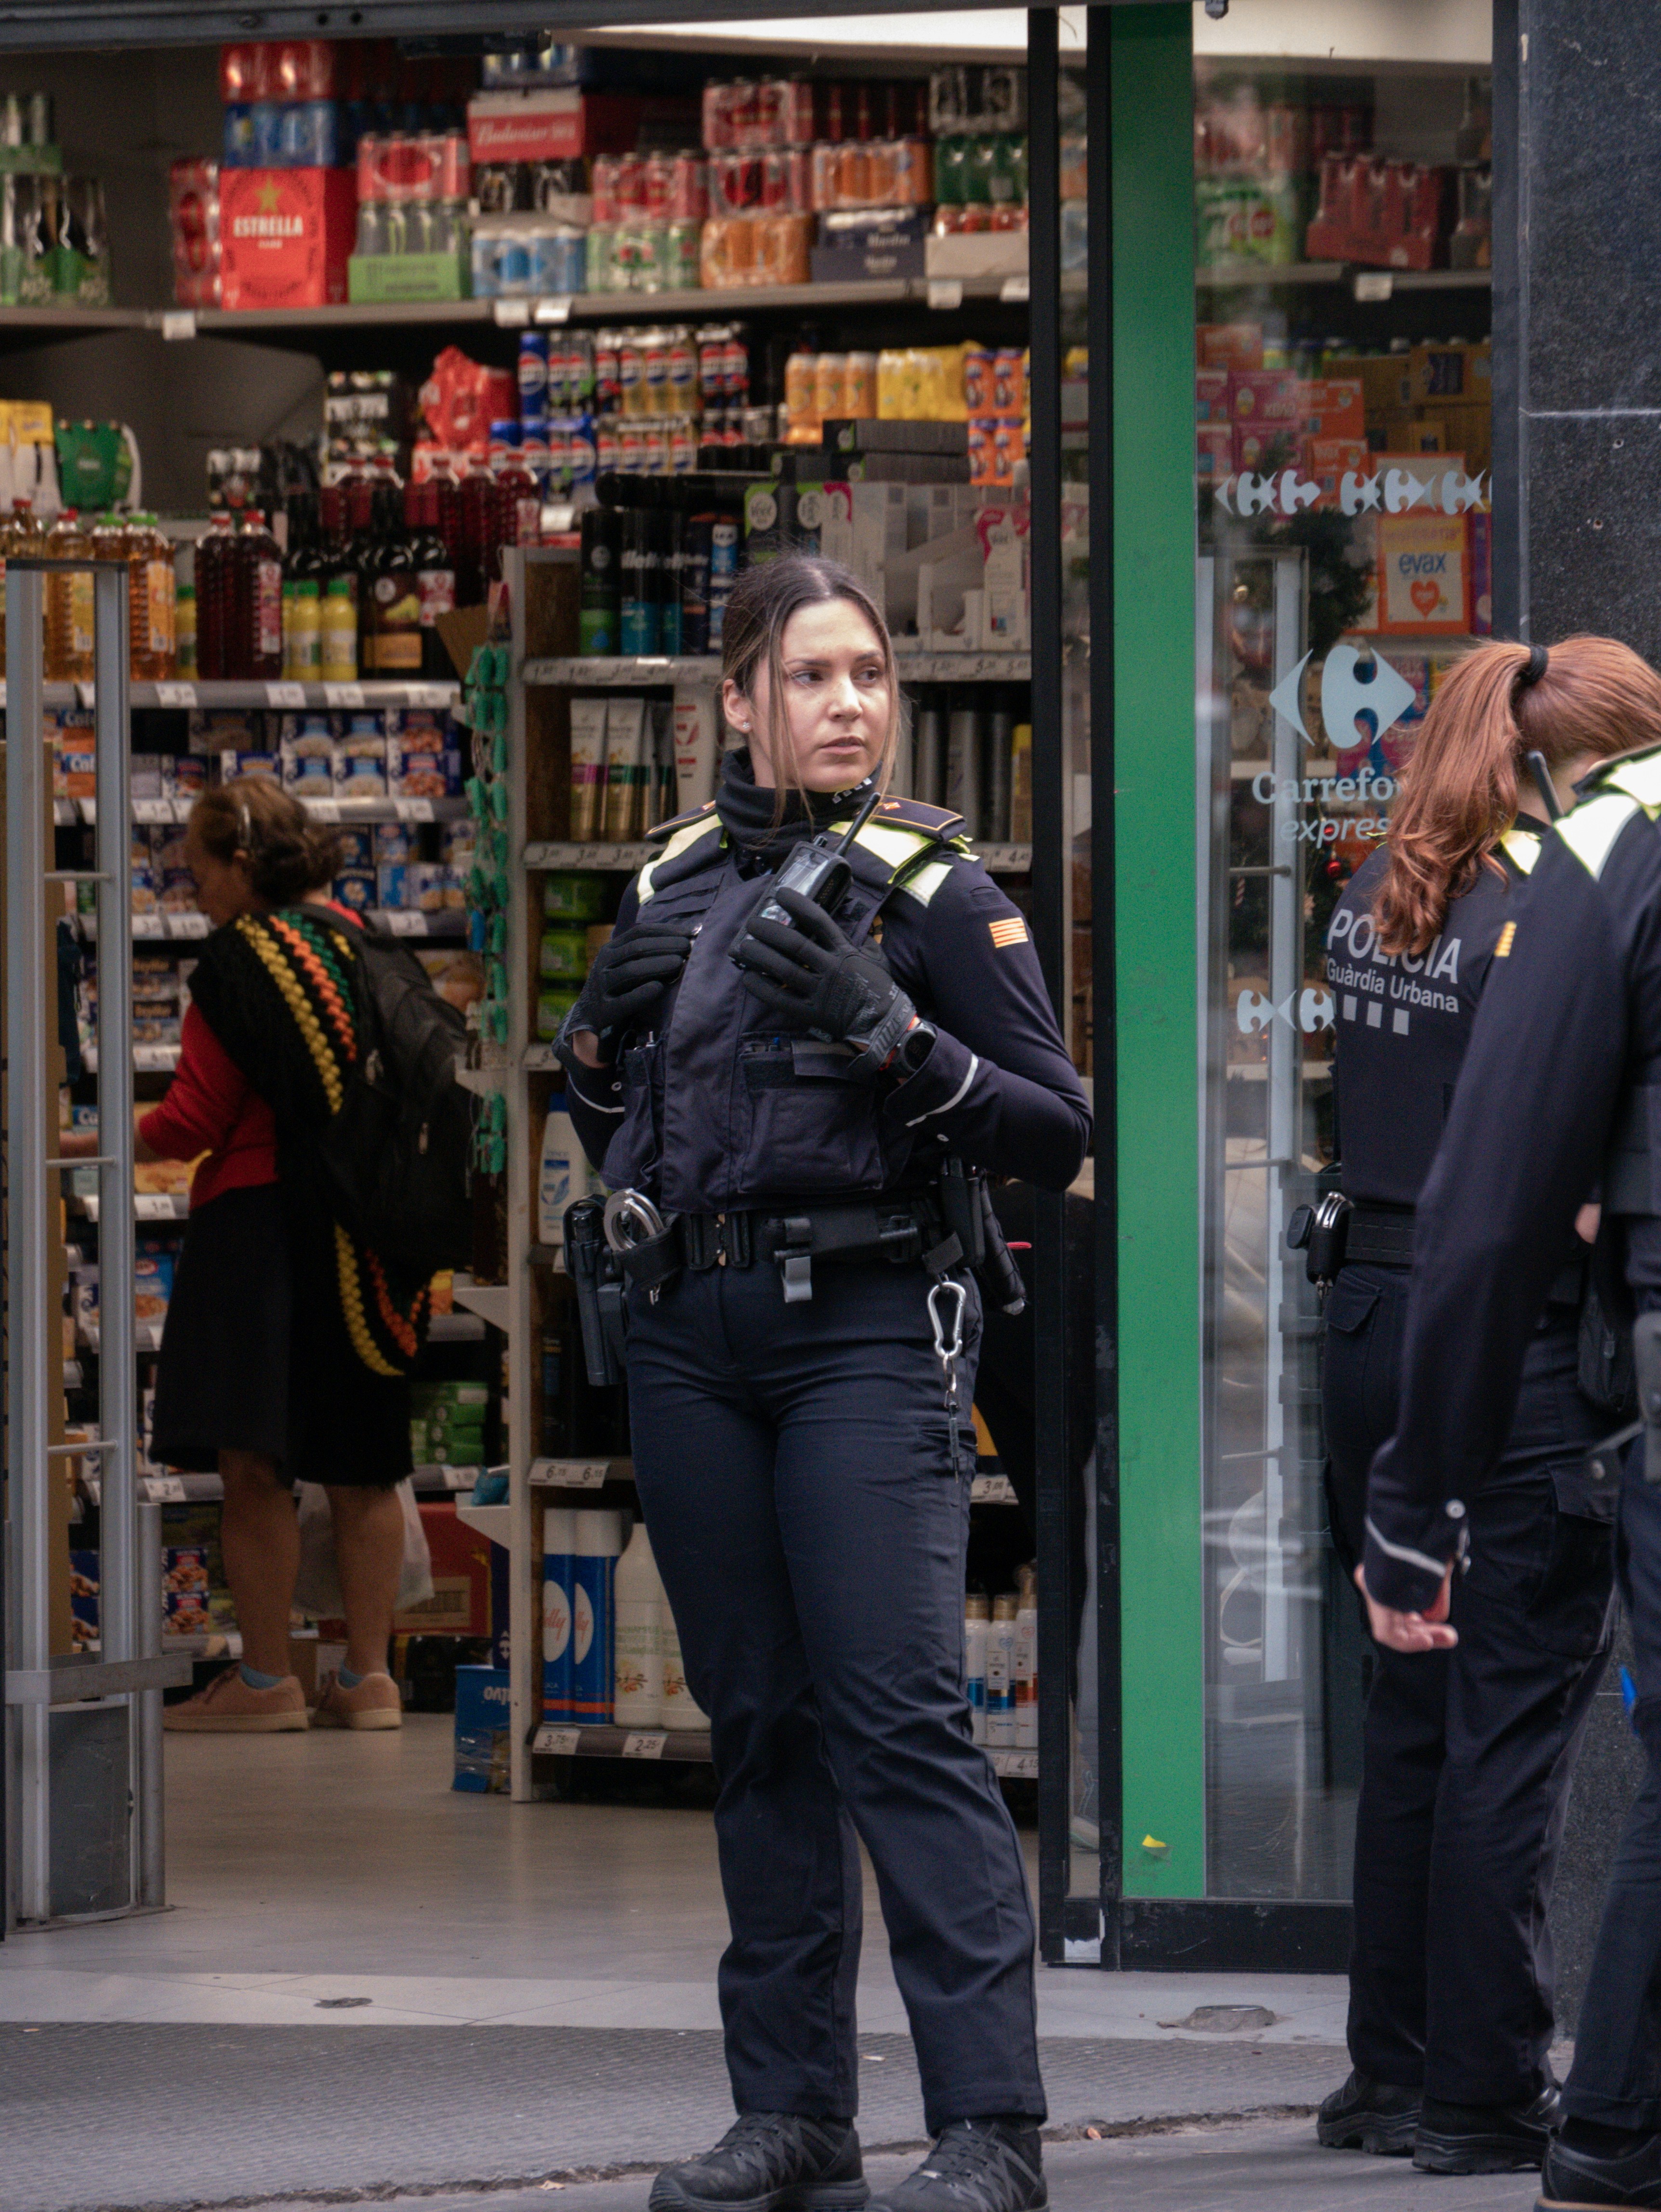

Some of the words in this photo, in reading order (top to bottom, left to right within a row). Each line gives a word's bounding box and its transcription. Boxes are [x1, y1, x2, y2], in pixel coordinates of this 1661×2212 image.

[234, 215, 303, 237] ESTRELLA
[1398, 552, 1446, 575] evax
[1252, 767, 1401, 803] Carrefo
[1280, 817, 1392, 849] expres
[1327, 908, 1462, 984] POLCIA
[1327, 958, 1385, 995] Guàrdia
[1390, 975, 1459, 1013] Urbana
